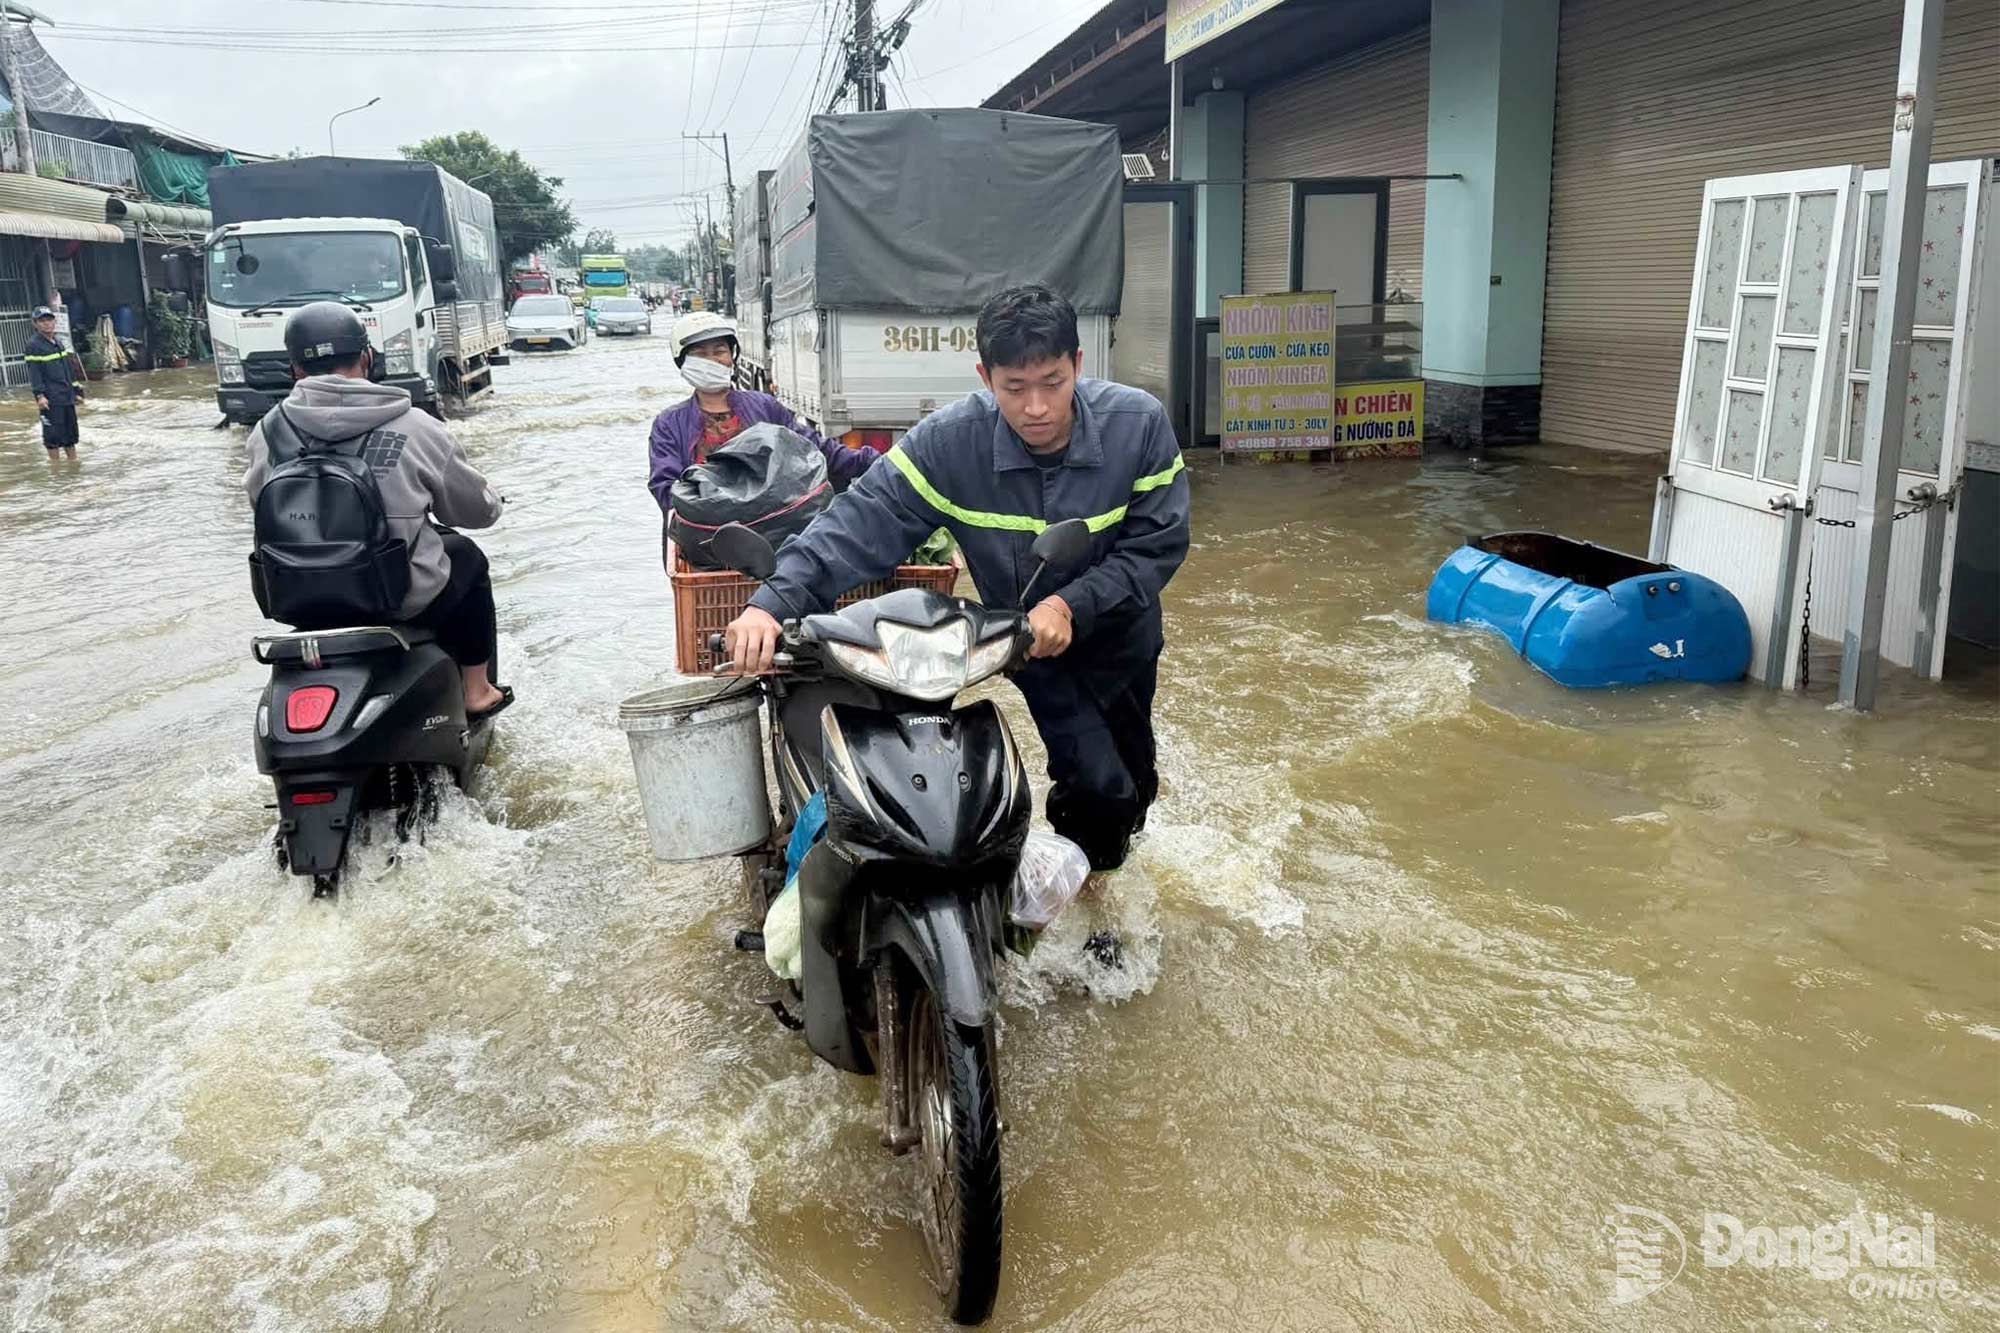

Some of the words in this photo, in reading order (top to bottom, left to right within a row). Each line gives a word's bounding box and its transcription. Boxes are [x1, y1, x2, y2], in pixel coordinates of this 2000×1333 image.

[1275, 365, 1327, 384] XINGFA
[1355, 390, 1412, 415] CHIÊN
[1289, 419, 1295, 430] 3
[908, 715, 951, 726] HONDA
